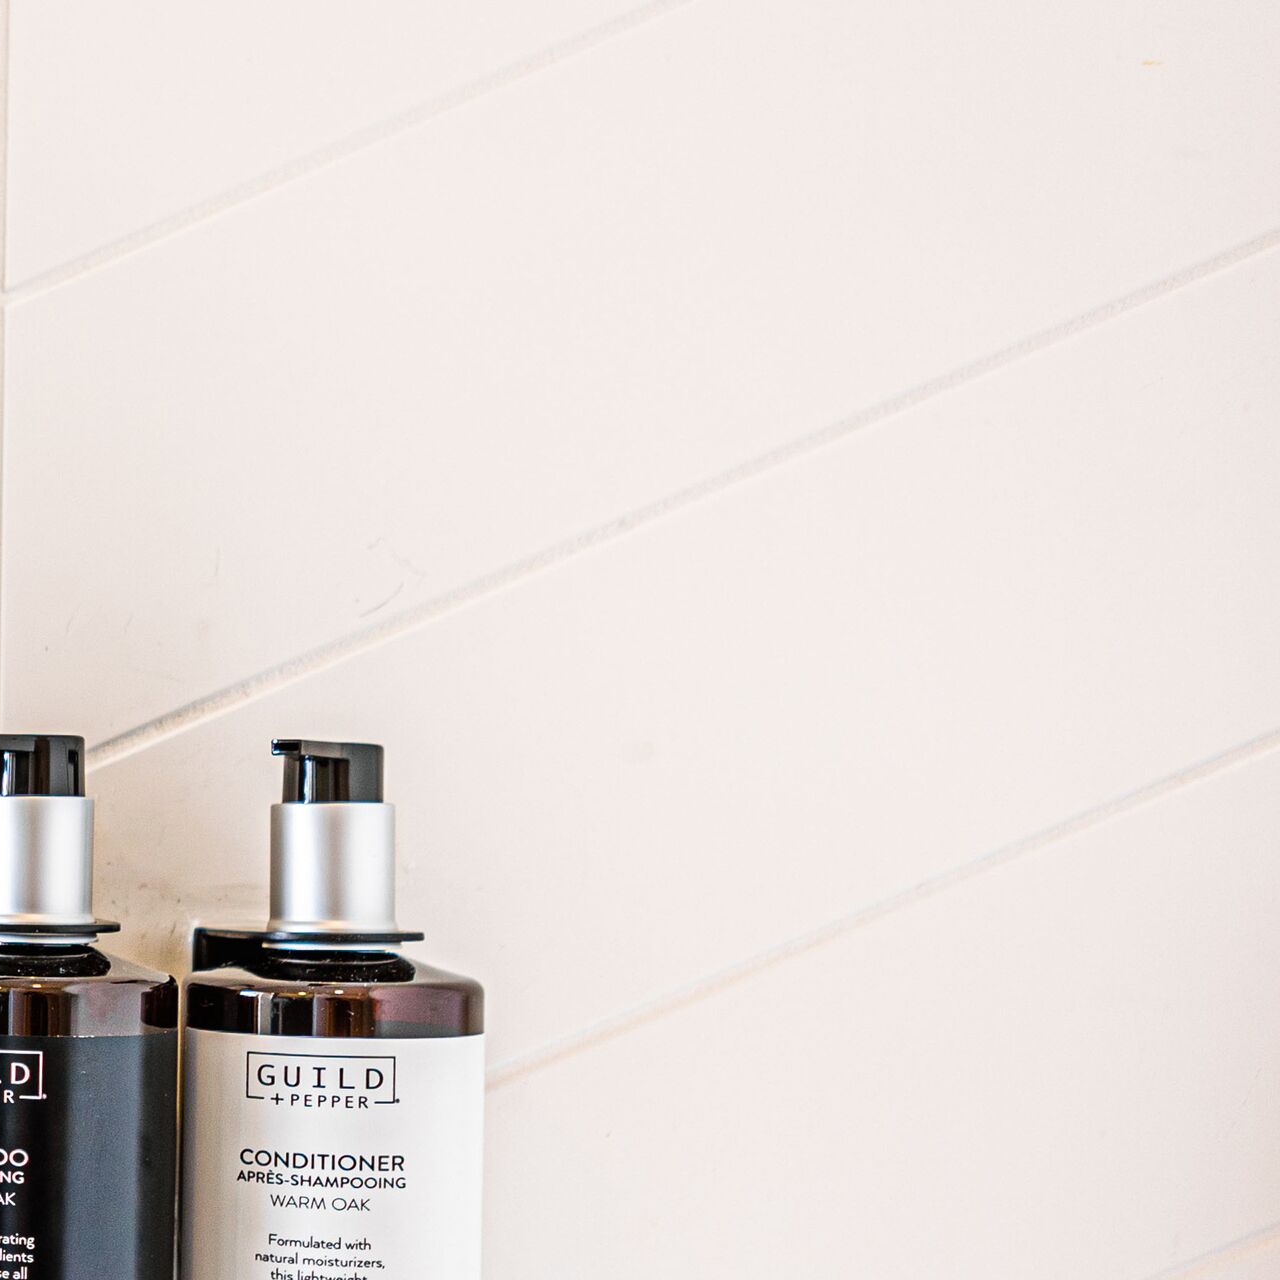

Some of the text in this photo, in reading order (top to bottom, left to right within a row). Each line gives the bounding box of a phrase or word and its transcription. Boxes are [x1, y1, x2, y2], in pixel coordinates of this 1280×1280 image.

[257, 1064, 384, 1090] GUILD
[240, 1148, 405, 1172] CONDITIONER
[236, 1169, 407, 1189] APRÈS-SHAMPOOING
[270, 1194, 370, 1211] WARM OAK
[268, 1234, 371, 1251] Formulated with
[255, 1251, 385, 1270] natural moisturizers,
[13, 1266, 28, 1280] all
